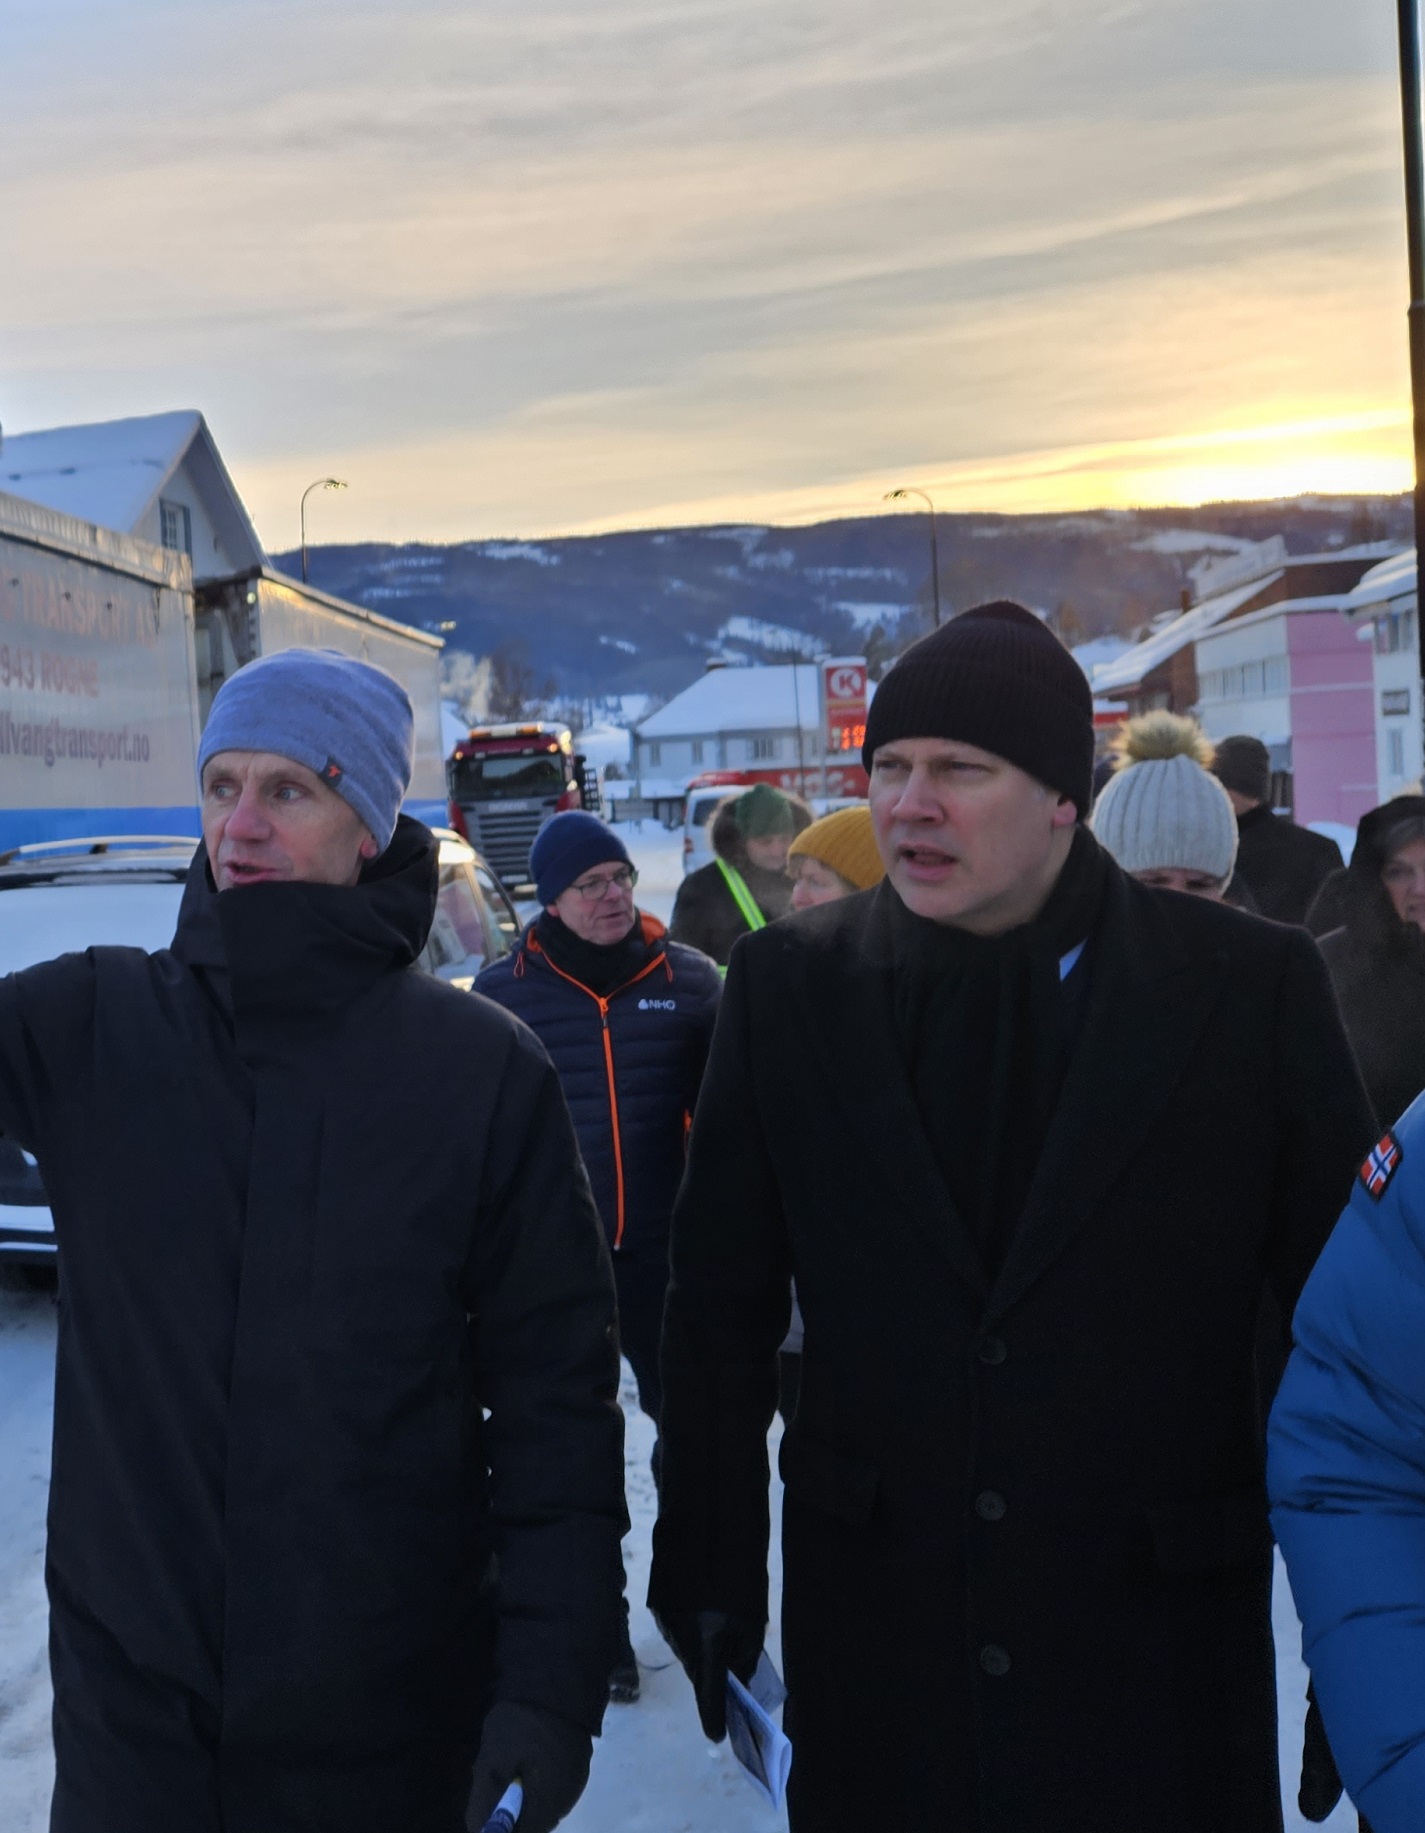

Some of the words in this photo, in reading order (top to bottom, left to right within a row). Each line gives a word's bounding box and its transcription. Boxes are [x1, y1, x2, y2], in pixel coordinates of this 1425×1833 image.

[21, 567, 130, 644] TRANSPORT
[40, 651, 100, 698] ROGNE
[648, 999, 676, 1011] NHO
